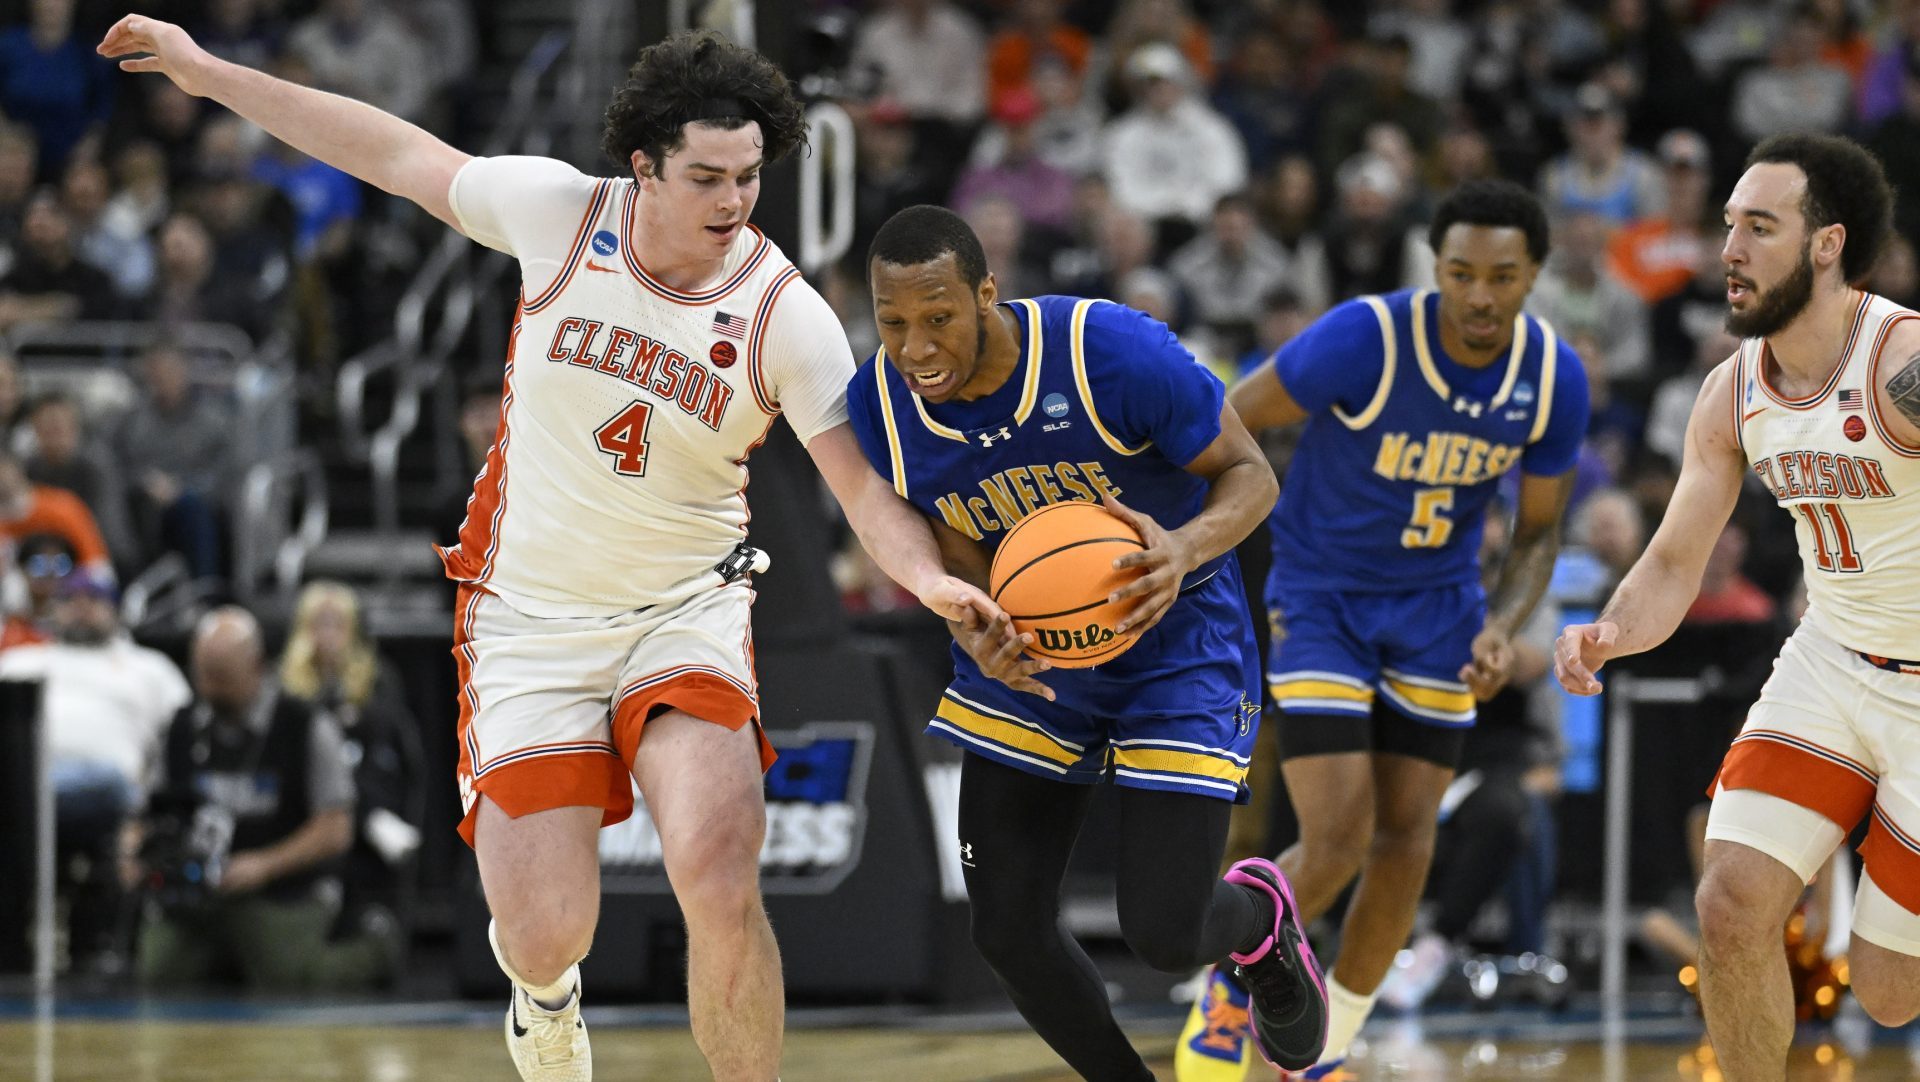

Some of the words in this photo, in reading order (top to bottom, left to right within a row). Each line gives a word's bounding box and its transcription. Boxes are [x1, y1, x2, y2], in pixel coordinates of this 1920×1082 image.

[594, 237, 615, 254] NCAA
[547, 316, 735, 433] CLEMSON
[1042, 421, 1071, 432] SLC
[1047, 402, 1069, 414] NCAA
[592, 399, 654, 477] 4
[1401, 487, 1455, 549] 5
[1796, 502, 1864, 573] 11
[1034, 623, 1122, 651] Wils
